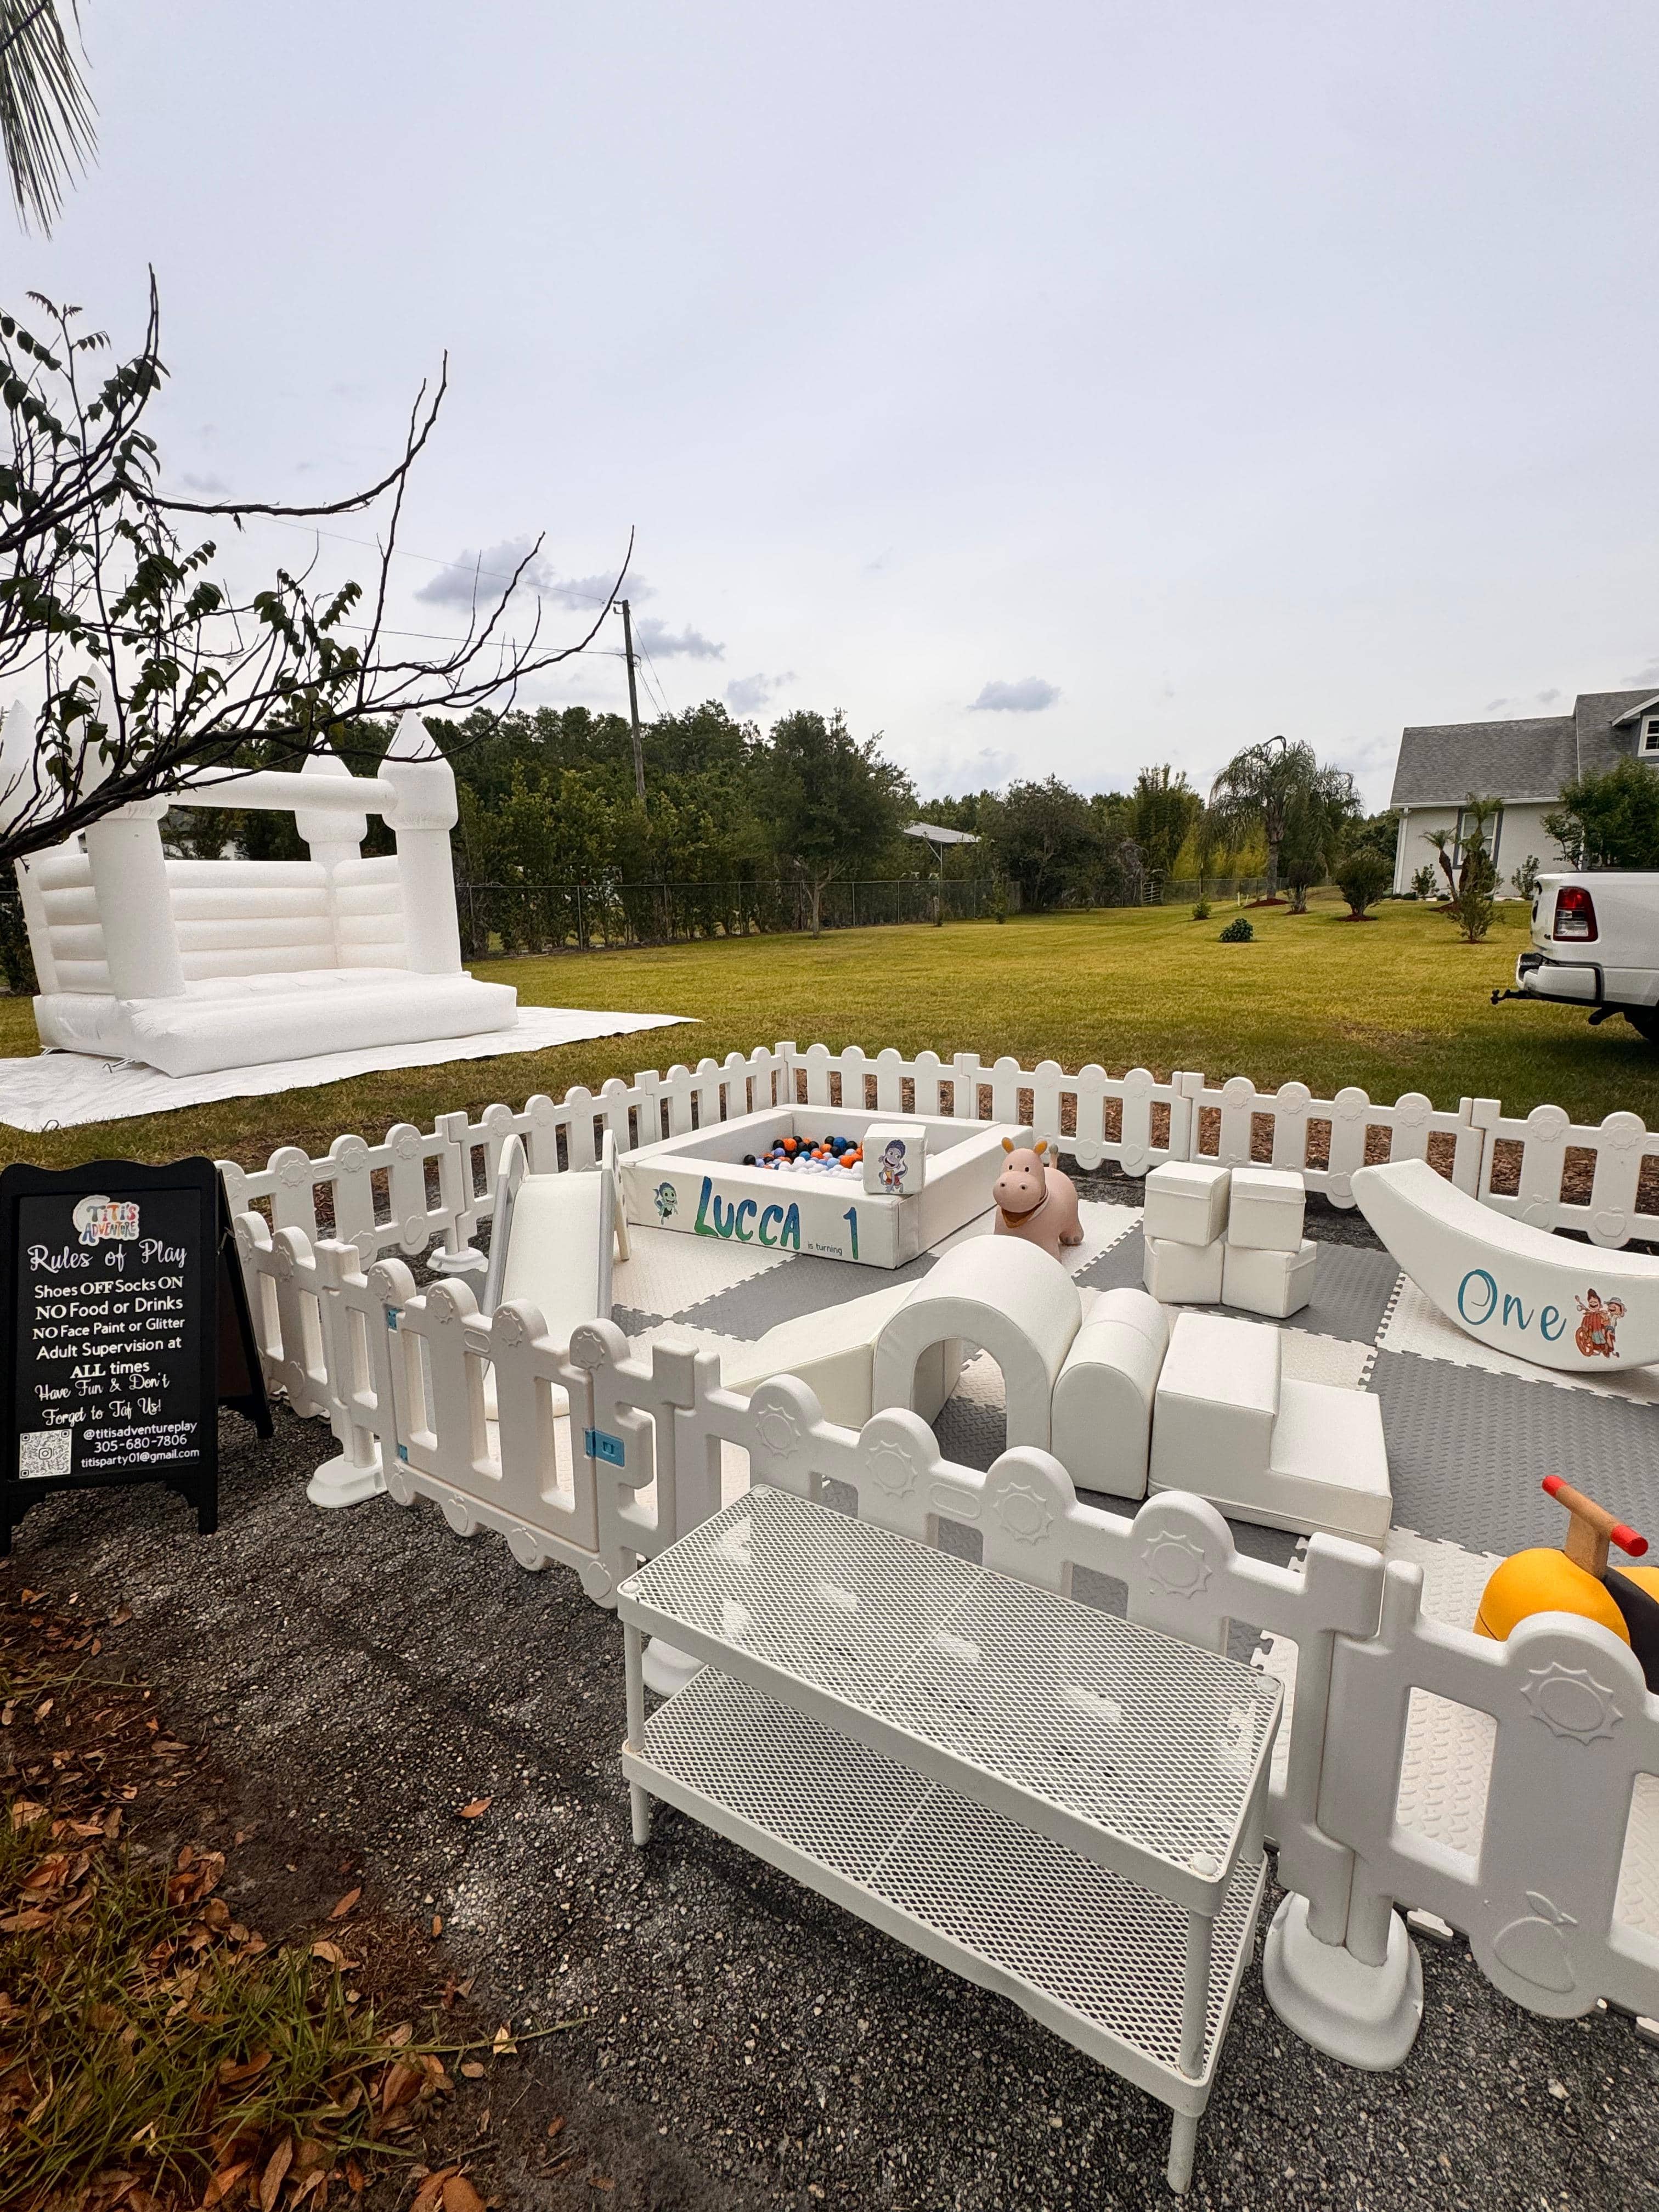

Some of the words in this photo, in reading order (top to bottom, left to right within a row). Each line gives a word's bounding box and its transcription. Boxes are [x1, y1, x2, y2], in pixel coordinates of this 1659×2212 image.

[694, 1176, 801, 1250] LUCCA
[843, 1206, 859, 1260] 1
[27, 1245, 93, 1273] Rules
[104, 1244, 126, 1272] of
[138, 1238, 187, 1268] Play
[808, 1241, 814, 1250] is
[815, 1243, 843, 1256] turning
[35, 1285, 78, 1299] Shoes
[80, 1281, 114, 1295] OFF
[115, 1278, 156, 1293] Socks
[158, 1276, 184, 1289] ON
[35, 1305, 66, 1320] NO
[70, 1301, 109, 1317] Food
[113, 1302, 130, 1313] or
[135, 1296, 183, 1312] Drinks
[1457, 1268, 1567, 1341] One
[32, 1327, 58, 1340] NO
[60, 1324, 89, 1338] Face
[93, 1322, 125, 1335] Paint
[128, 1323, 143, 1331] or
[145, 1318, 185, 1330] Glitter
[36, 1344, 78, 1360] Adult
[82, 1339, 163, 1357] Supervision
[167, 1337, 182, 1349] at
[70, 1364, 106, 1379] ALL
[110, 1361, 150, 1375] times
[35, 1384, 71, 1401] Have
[75, 1379, 104, 1396] Fun
[109, 1378, 122, 1392] &
[128, 1372, 170, 1390] Don't
[42, 1408, 86, 1427] Forget
[91, 1405, 104, 1420] to
[137, 1397, 162, 1415] Us!
[83, 1420, 198, 1441] @titisadventureplay
[94, 1434, 188, 1453] 305-680-7806
[81, 1449, 200, 1468] titisparty01@gmail.com
